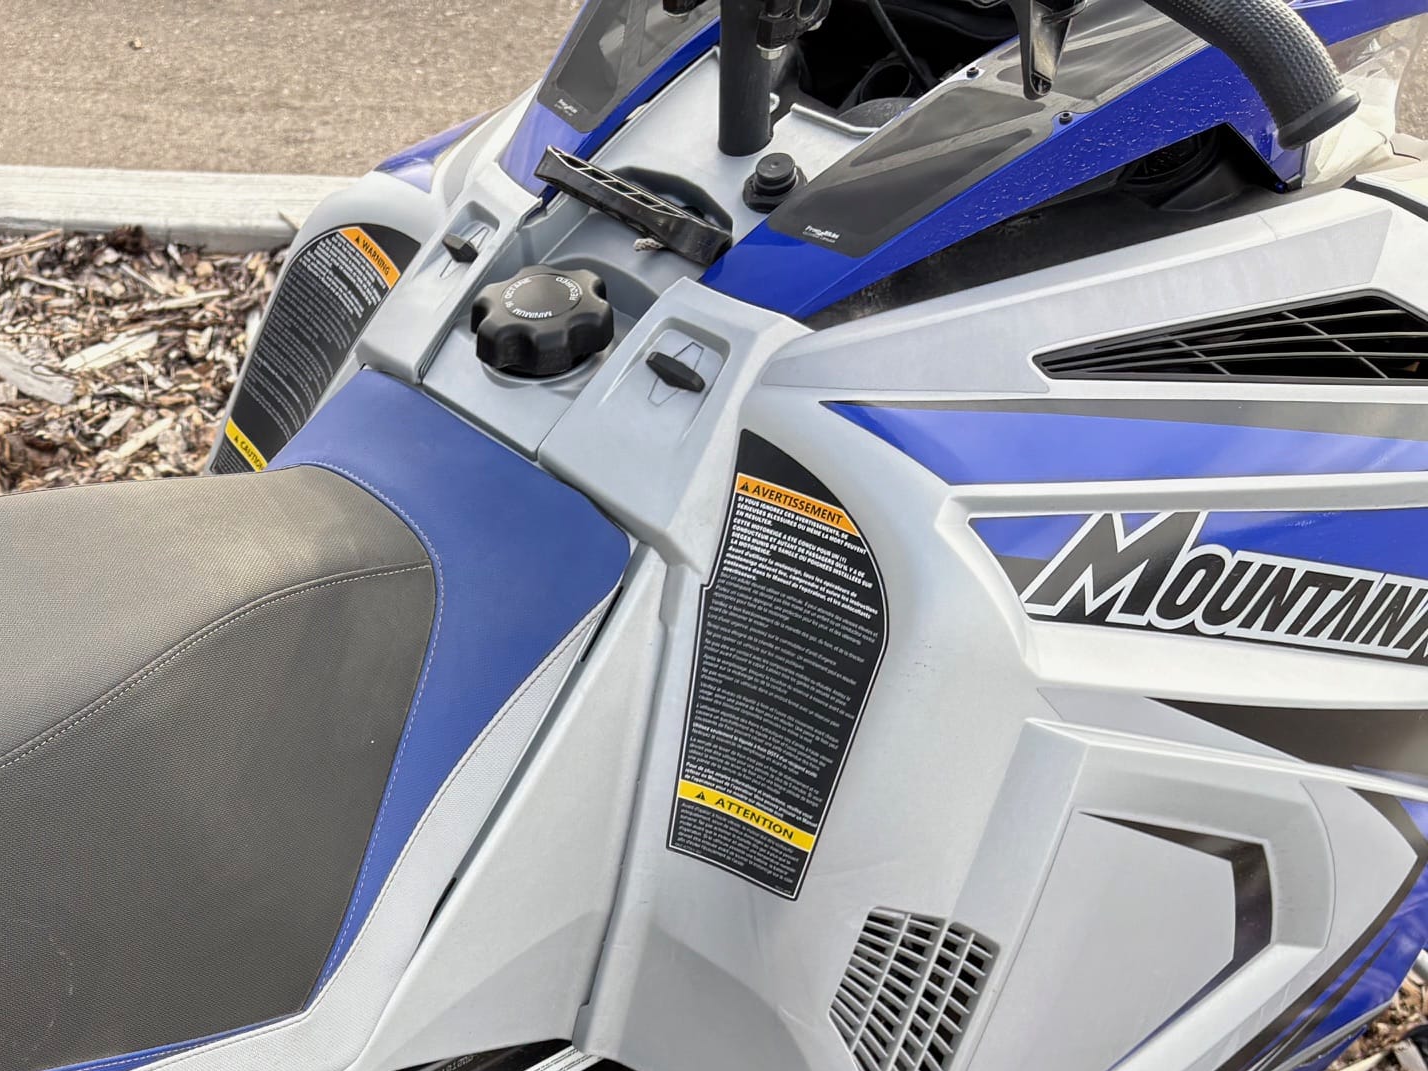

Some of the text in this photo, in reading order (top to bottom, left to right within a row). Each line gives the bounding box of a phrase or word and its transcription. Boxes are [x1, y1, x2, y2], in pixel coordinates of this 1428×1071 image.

[359, 238, 391, 275] WARNING
[512, 307, 553, 319] MINIMUM
[752, 484, 843, 525] AVERTISSEMENT
[1023, 511, 1428, 648] MOUNTAIN
[714, 797, 795, 839] ATTENTION
